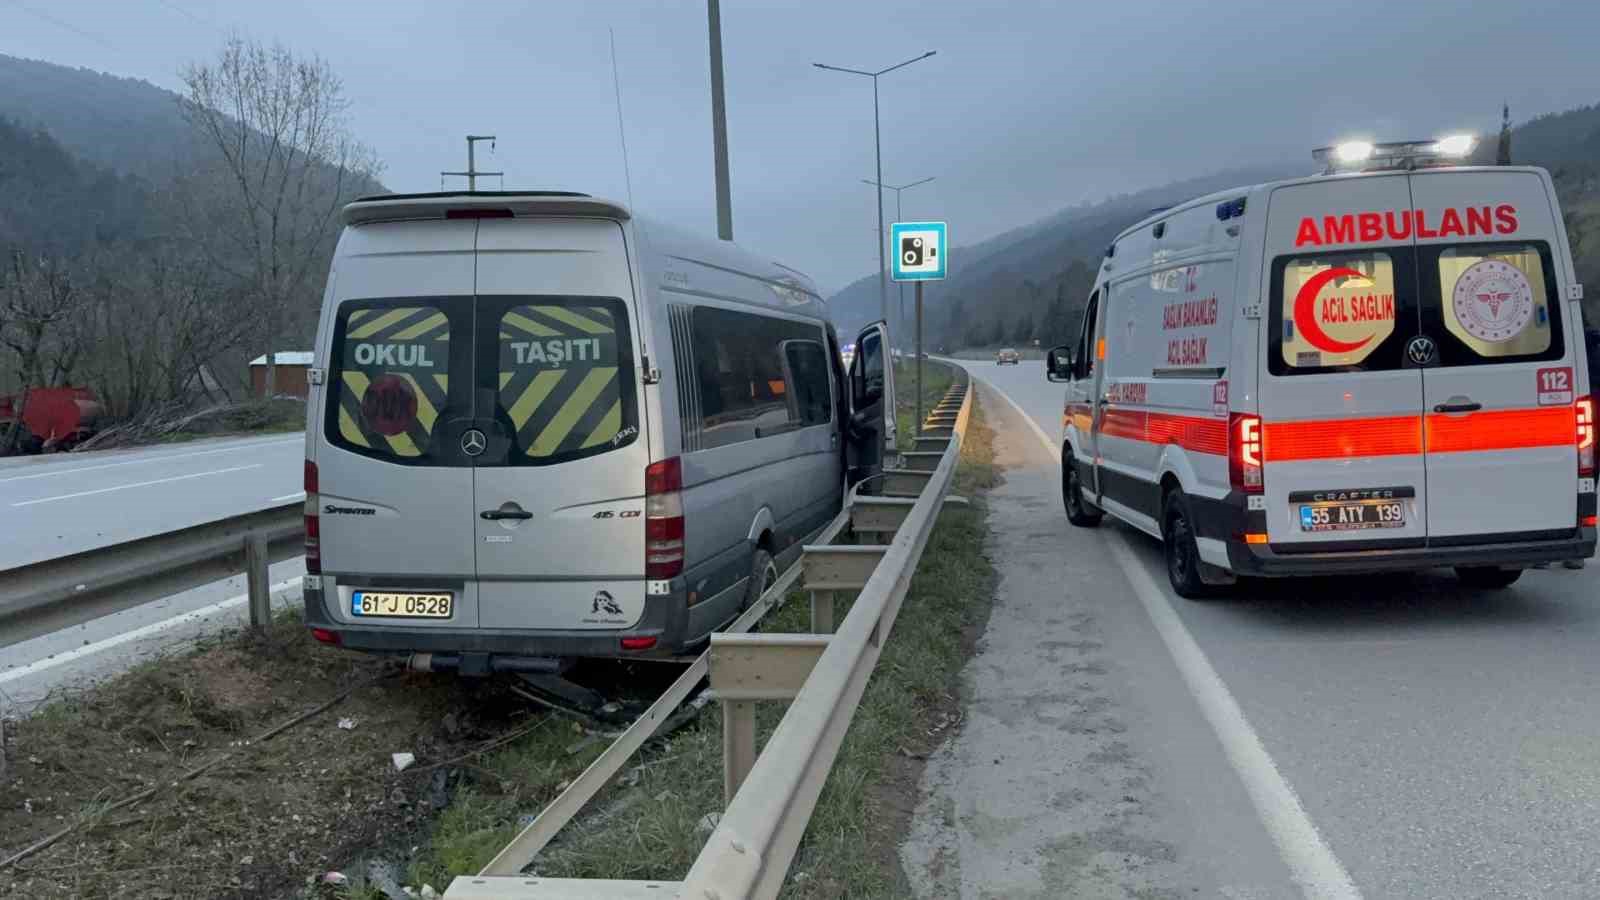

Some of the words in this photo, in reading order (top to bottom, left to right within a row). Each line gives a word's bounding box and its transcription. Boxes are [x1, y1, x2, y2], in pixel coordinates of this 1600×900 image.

[1295, 204, 1519, 247] AMBULANS
[1351, 292, 1394, 322] SAĞLIK
[354, 342, 434, 367] OKUL
[510, 338, 601, 368] TAŞITI
[1542, 371, 1568, 390] 112
[1313, 490, 1393, 501] CRAFTER
[619, 510, 641, 519] CDI
[1311, 508, 1330, 524] 55
[1339, 506, 1365, 523] ATY
[1376, 504, 1402, 521] 139
[362, 595, 379, 612] 61
[388, 596, 399, 613] J
[405, 597, 449, 614] 0528
